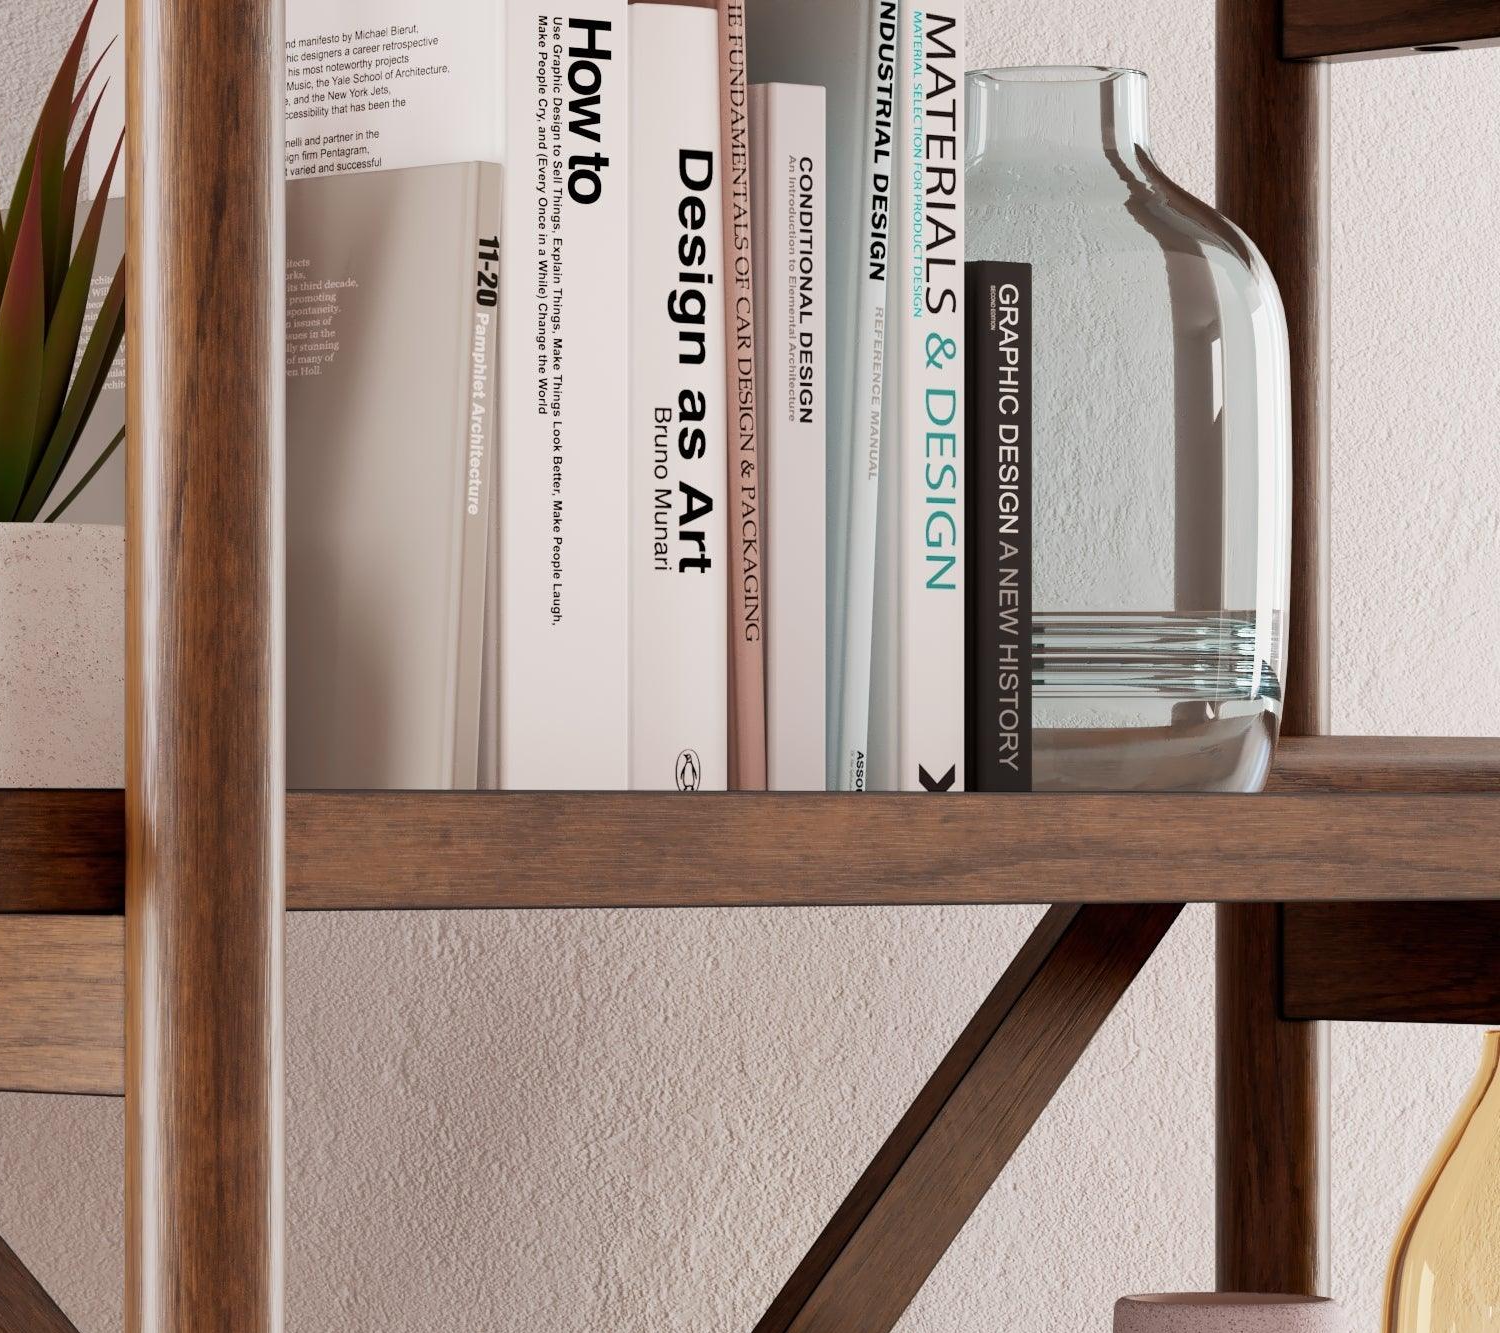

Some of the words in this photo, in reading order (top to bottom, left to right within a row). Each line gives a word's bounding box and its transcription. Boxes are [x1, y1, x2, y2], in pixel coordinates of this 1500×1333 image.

[299, 34, 340, 47] manifesto
[342, 32, 352, 44] by
[355, 27, 388, 40] Michael
[301, 48, 342, 61] designers
[352, 44, 380, 55] career
[382, 37, 439, 51] retrospective
[538, 15, 548, 48] Make
[552, 16, 563, 40] Use
[913, 11, 923, 78] MATERIAL
[286, 80, 314, 91] Music,
[316, 78, 330, 88] the
[332, 75, 350, 86] Yale
[353, 70, 382, 84] School
[384, 69, 394, 80] of
[395, 64, 450, 79] Architecture,
[288, 67, 300, 77] his
[302, 65, 323, 75] most
[325, 58, 372, 73] noteworthy
[375, 54, 410, 68] projects
[536, 52, 548, 95] People
[550, 44, 563, 94] Graphic
[567, 18, 612, 143] How
[293, 94, 310, 105] and
[311, 92, 325, 102] the
[328, 91, 346, 100] New
[349, 87, 368, 98] York
[370, 85, 391, 96] Jets,
[331, 104, 348, 115] that
[350, 102, 366, 112] has
[368, 100, 390, 110] been
[392, 98, 406, 108] the
[536, 98, 548, 122] Cry,
[304, 135, 320, 146] and
[323, 133, 353, 146] partner
[355, 130, 364, 139] in
[366, 129, 380, 139] the
[538, 126, 548, 150] and
[550, 97, 563, 142] Design
[913, 83, 923, 158] SELECTION
[302, 150, 318, 160] firm
[320, 145, 370, 159] Pentagram,
[552, 145, 562, 157] to
[729, 35, 750, 251] FUNDAMENTALS
[788, 154, 797, 173] An
[926, 13, 957, 314] MATERIALS
[290, 164, 316, 176] varied
[318, 162, 335, 173] and
[336, 157, 382, 171] successful
[536, 154, 548, 193] (Every
[552, 162, 563, 185] Sell
[567, 152, 610, 205] to
[913, 163, 923, 190] FOR
[538, 197, 548, 230] Once
[550, 187, 563, 233] Things,
[788, 177, 797, 255] Introduction
[869, 173, 889, 281] DESIGN
[913, 194, 923, 261] PRODUCT
[538, 233, 548, 245] in
[667, 149, 713, 364] Design
[799, 157, 813, 324] CONDITIONAL
[476, 235, 500, 307] 11-20
[536, 260, 548, 299] While)
[550, 238, 563, 284] Explain
[735, 256, 750, 290] OF
[788, 259, 797, 272] to
[289, 292, 337, 306] promoting
[300, 280, 322, 291] third
[913, 266, 923, 318] DESIGN
[322, 316, 332, 325] of
[536, 303, 548, 350] Change
[550, 288, 563, 334] Things,
[736, 297, 751, 350] CAR
[788, 276, 797, 339] Elemental
[320, 328, 336, 339] the
[552, 338, 563, 371] Make
[925, 332, 957, 369] &
[998, 283, 1019, 415] GRAPHIC
[297, 353, 323, 365] many
[324, 351, 335, 362] of
[471, 312, 490, 399] Pamphlet
[538, 354, 548, 374] the
[870, 306, 884, 405] REFERENCE
[538, 378, 548, 415] World
[550, 374, 563, 417] Things
[788, 343, 797, 422] Architecture
[799, 332, 813, 423] DESIGN
[678, 389, 706, 460] as
[737, 357, 755, 451] DESIGN
[552, 421, 563, 452] Look
[654, 407, 672, 480] Bruno
[867, 411, 880, 481] MANUAL
[467, 402, 486, 516] Architecture
[550, 456, 563, 496] Better,
[740, 460, 755, 478] &
[998, 424, 1019, 534] DESIGN
[925, 388, 957, 590] DESIGN
[552, 500, 563, 533] Make
[654, 489, 672, 571] Munari
[678, 481, 713, 573] Art
[550, 537, 563, 579] People
[741, 486, 760, 642] PACKAGING
[999, 541, 1019, 561] A
[550, 583, 563, 626] Laugh,
[998, 569, 1019, 635] NEW
[998, 644, 1019, 772] HISTORY
[855, 750, 865, 792] ASSO
